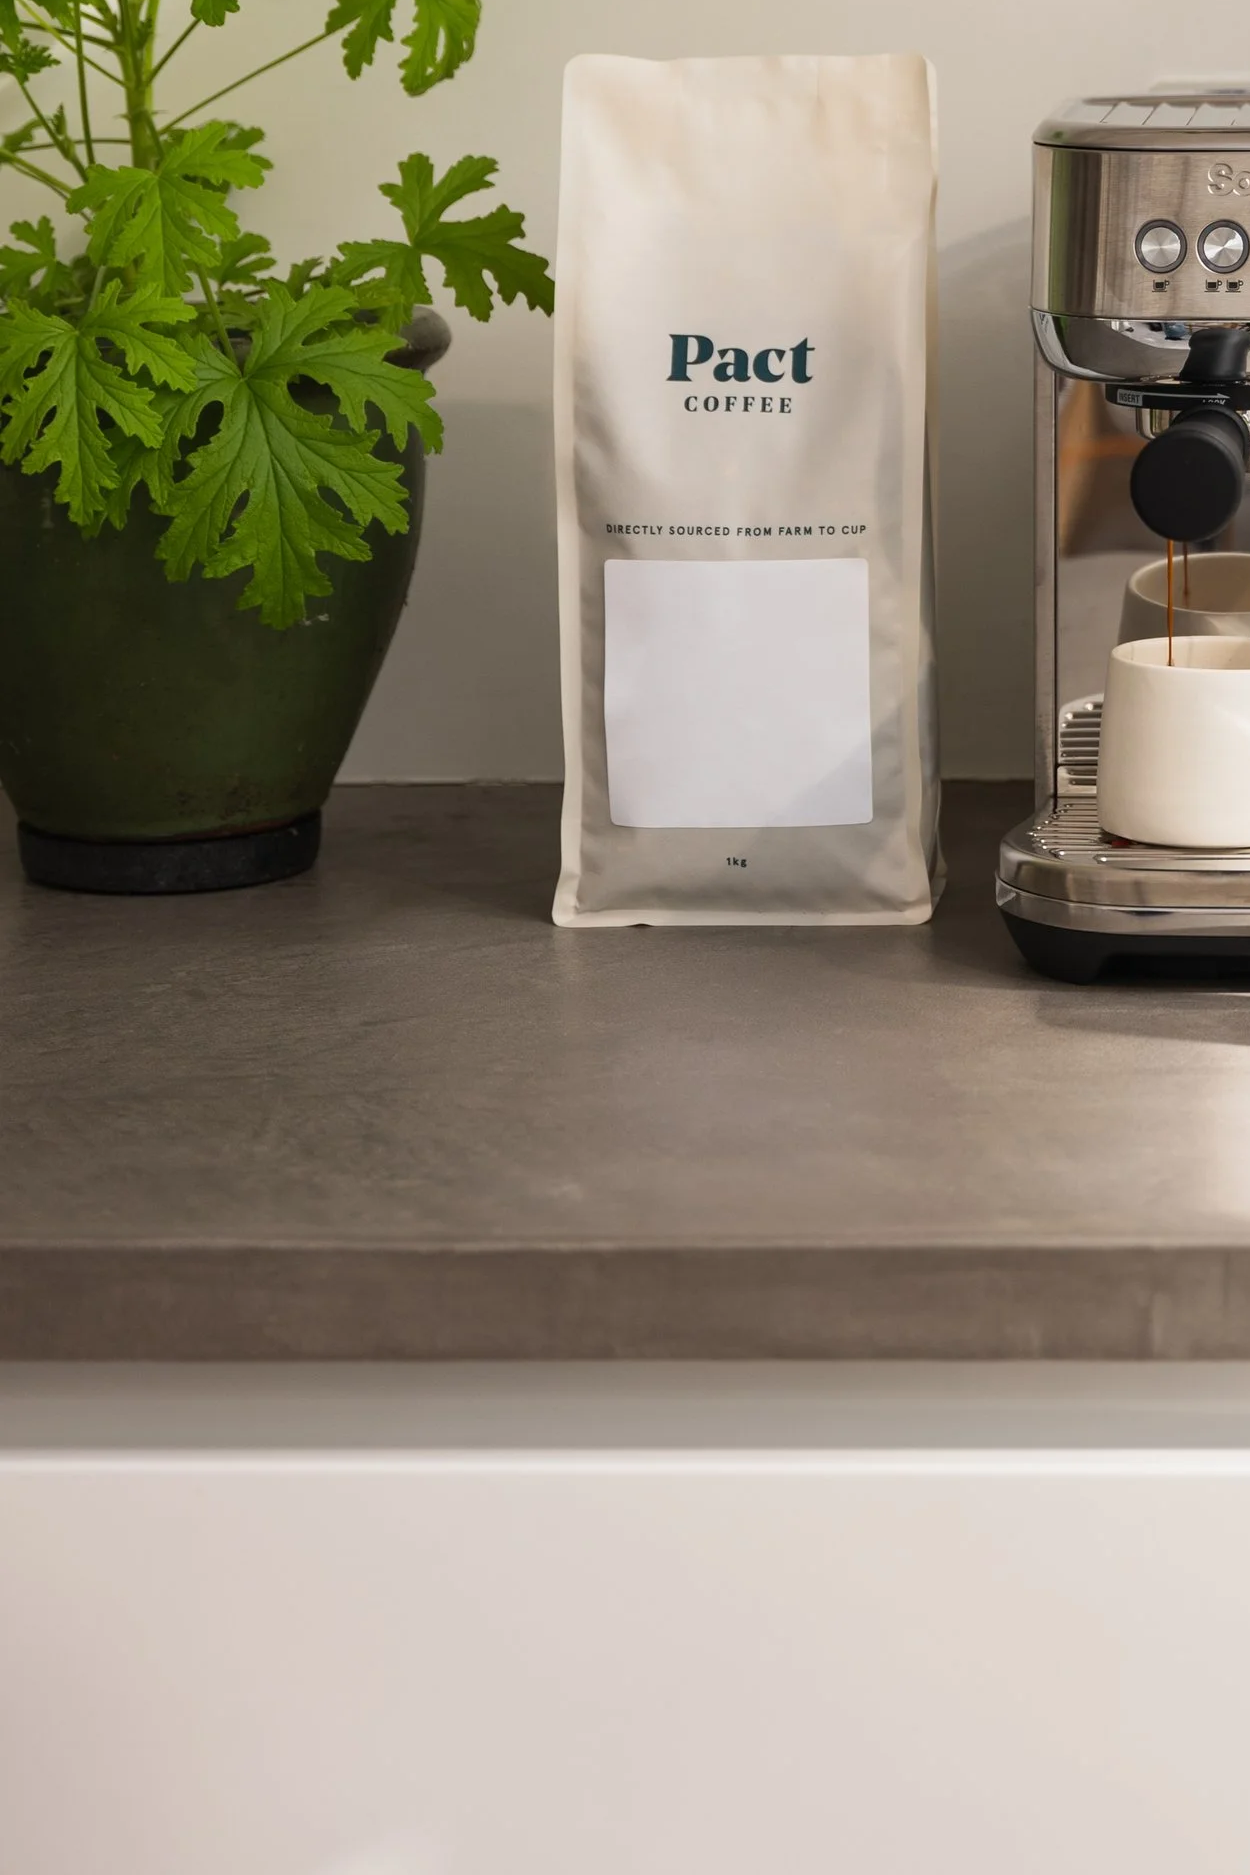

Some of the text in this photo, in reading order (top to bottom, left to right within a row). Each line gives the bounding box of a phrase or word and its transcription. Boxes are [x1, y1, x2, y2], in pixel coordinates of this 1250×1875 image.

[665, 333, 816, 385] Pact
[683, 395, 793, 414] COFFEE
[606, 523, 867, 537] DIRECTLY SOURCED FROM FARM TO CUP
[726, 856, 748, 868] 1kg
